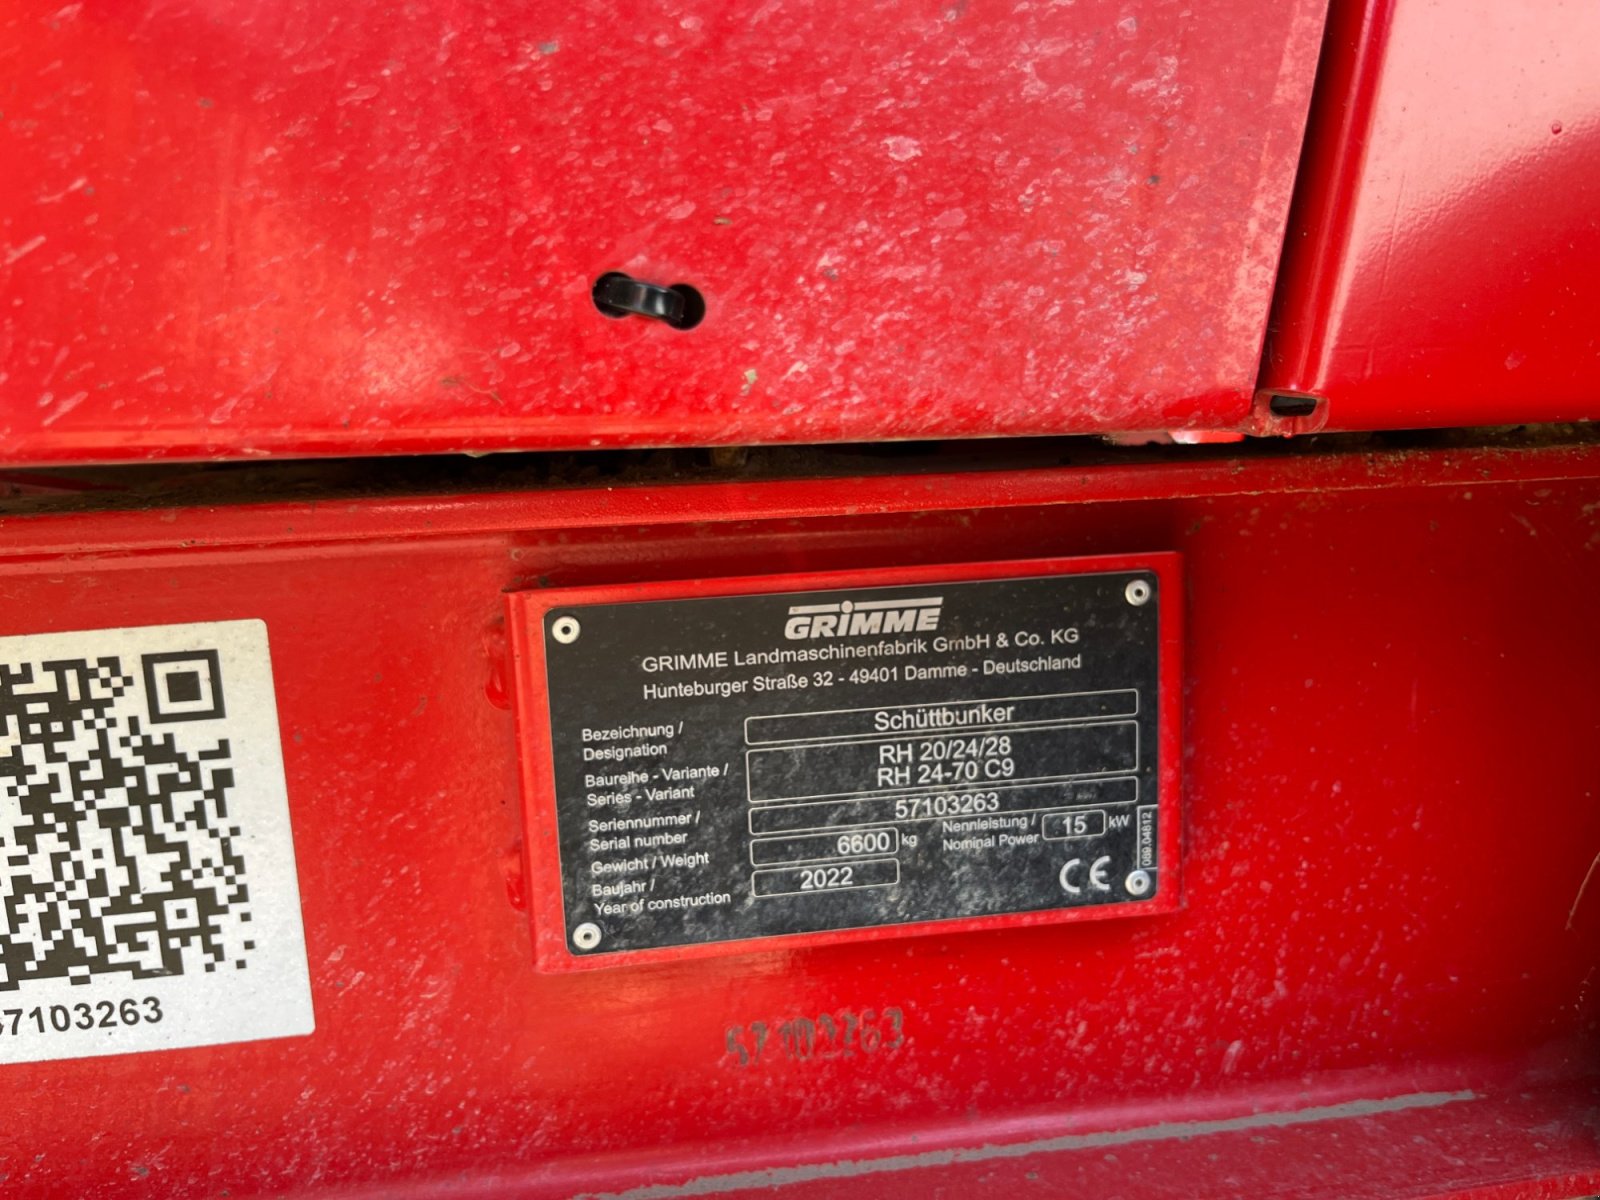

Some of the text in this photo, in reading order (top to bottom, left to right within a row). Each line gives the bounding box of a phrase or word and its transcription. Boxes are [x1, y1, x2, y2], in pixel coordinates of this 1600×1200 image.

[784, 600, 943, 640] GRIMME
[641, 628, 1079, 673] GRIMME Landmaschinenfabrik GmbH & Co. KG
[643, 678, 749, 700] Hunteburger
[753, 674, 808, 692] Straße
[813, 671, 834, 687] 32
[849, 667, 899, 685] 49401
[905, 663, 967, 682] Damme
[983, 654, 1082, 676] Deutschland
[874, 704, 1015, 731] Schüttbunker
[582, 721, 684, 741] Bezeichnung /
[583, 743, 667, 761] Designation
[879, 736, 1012, 764] RH 20/24/28
[585, 771, 649, 788] Baureihe
[662, 765, 720, 781] Variante
[723, 763, 729, 775] /
[877, 758, 1015, 787] RH 24-70 C9
[587, 792, 632, 806] Series
[645, 786, 695, 801] Variant
[895, 792, 1000, 818] 57103263
[588, 811, 701, 832] Seriennummer /
[943, 814, 1036, 833] Nennleistung /
[1063, 815, 1130, 834] 15 kW
[589, 832, 688, 851] Serial number
[837, 832, 918, 855] 6600 kg
[943, 832, 1040, 851] Nominal Power
[1141, 811, 1152, 866] 089.04812
[591, 852, 710, 874] Gewicht / Weight
[1059, 855, 1111, 893] CE
[592, 879, 655, 897] Baujahr /
[801, 867, 853, 889] 2022
[594, 892, 731, 915] Year of construction
[0, 996, 163, 1035] 7103263
